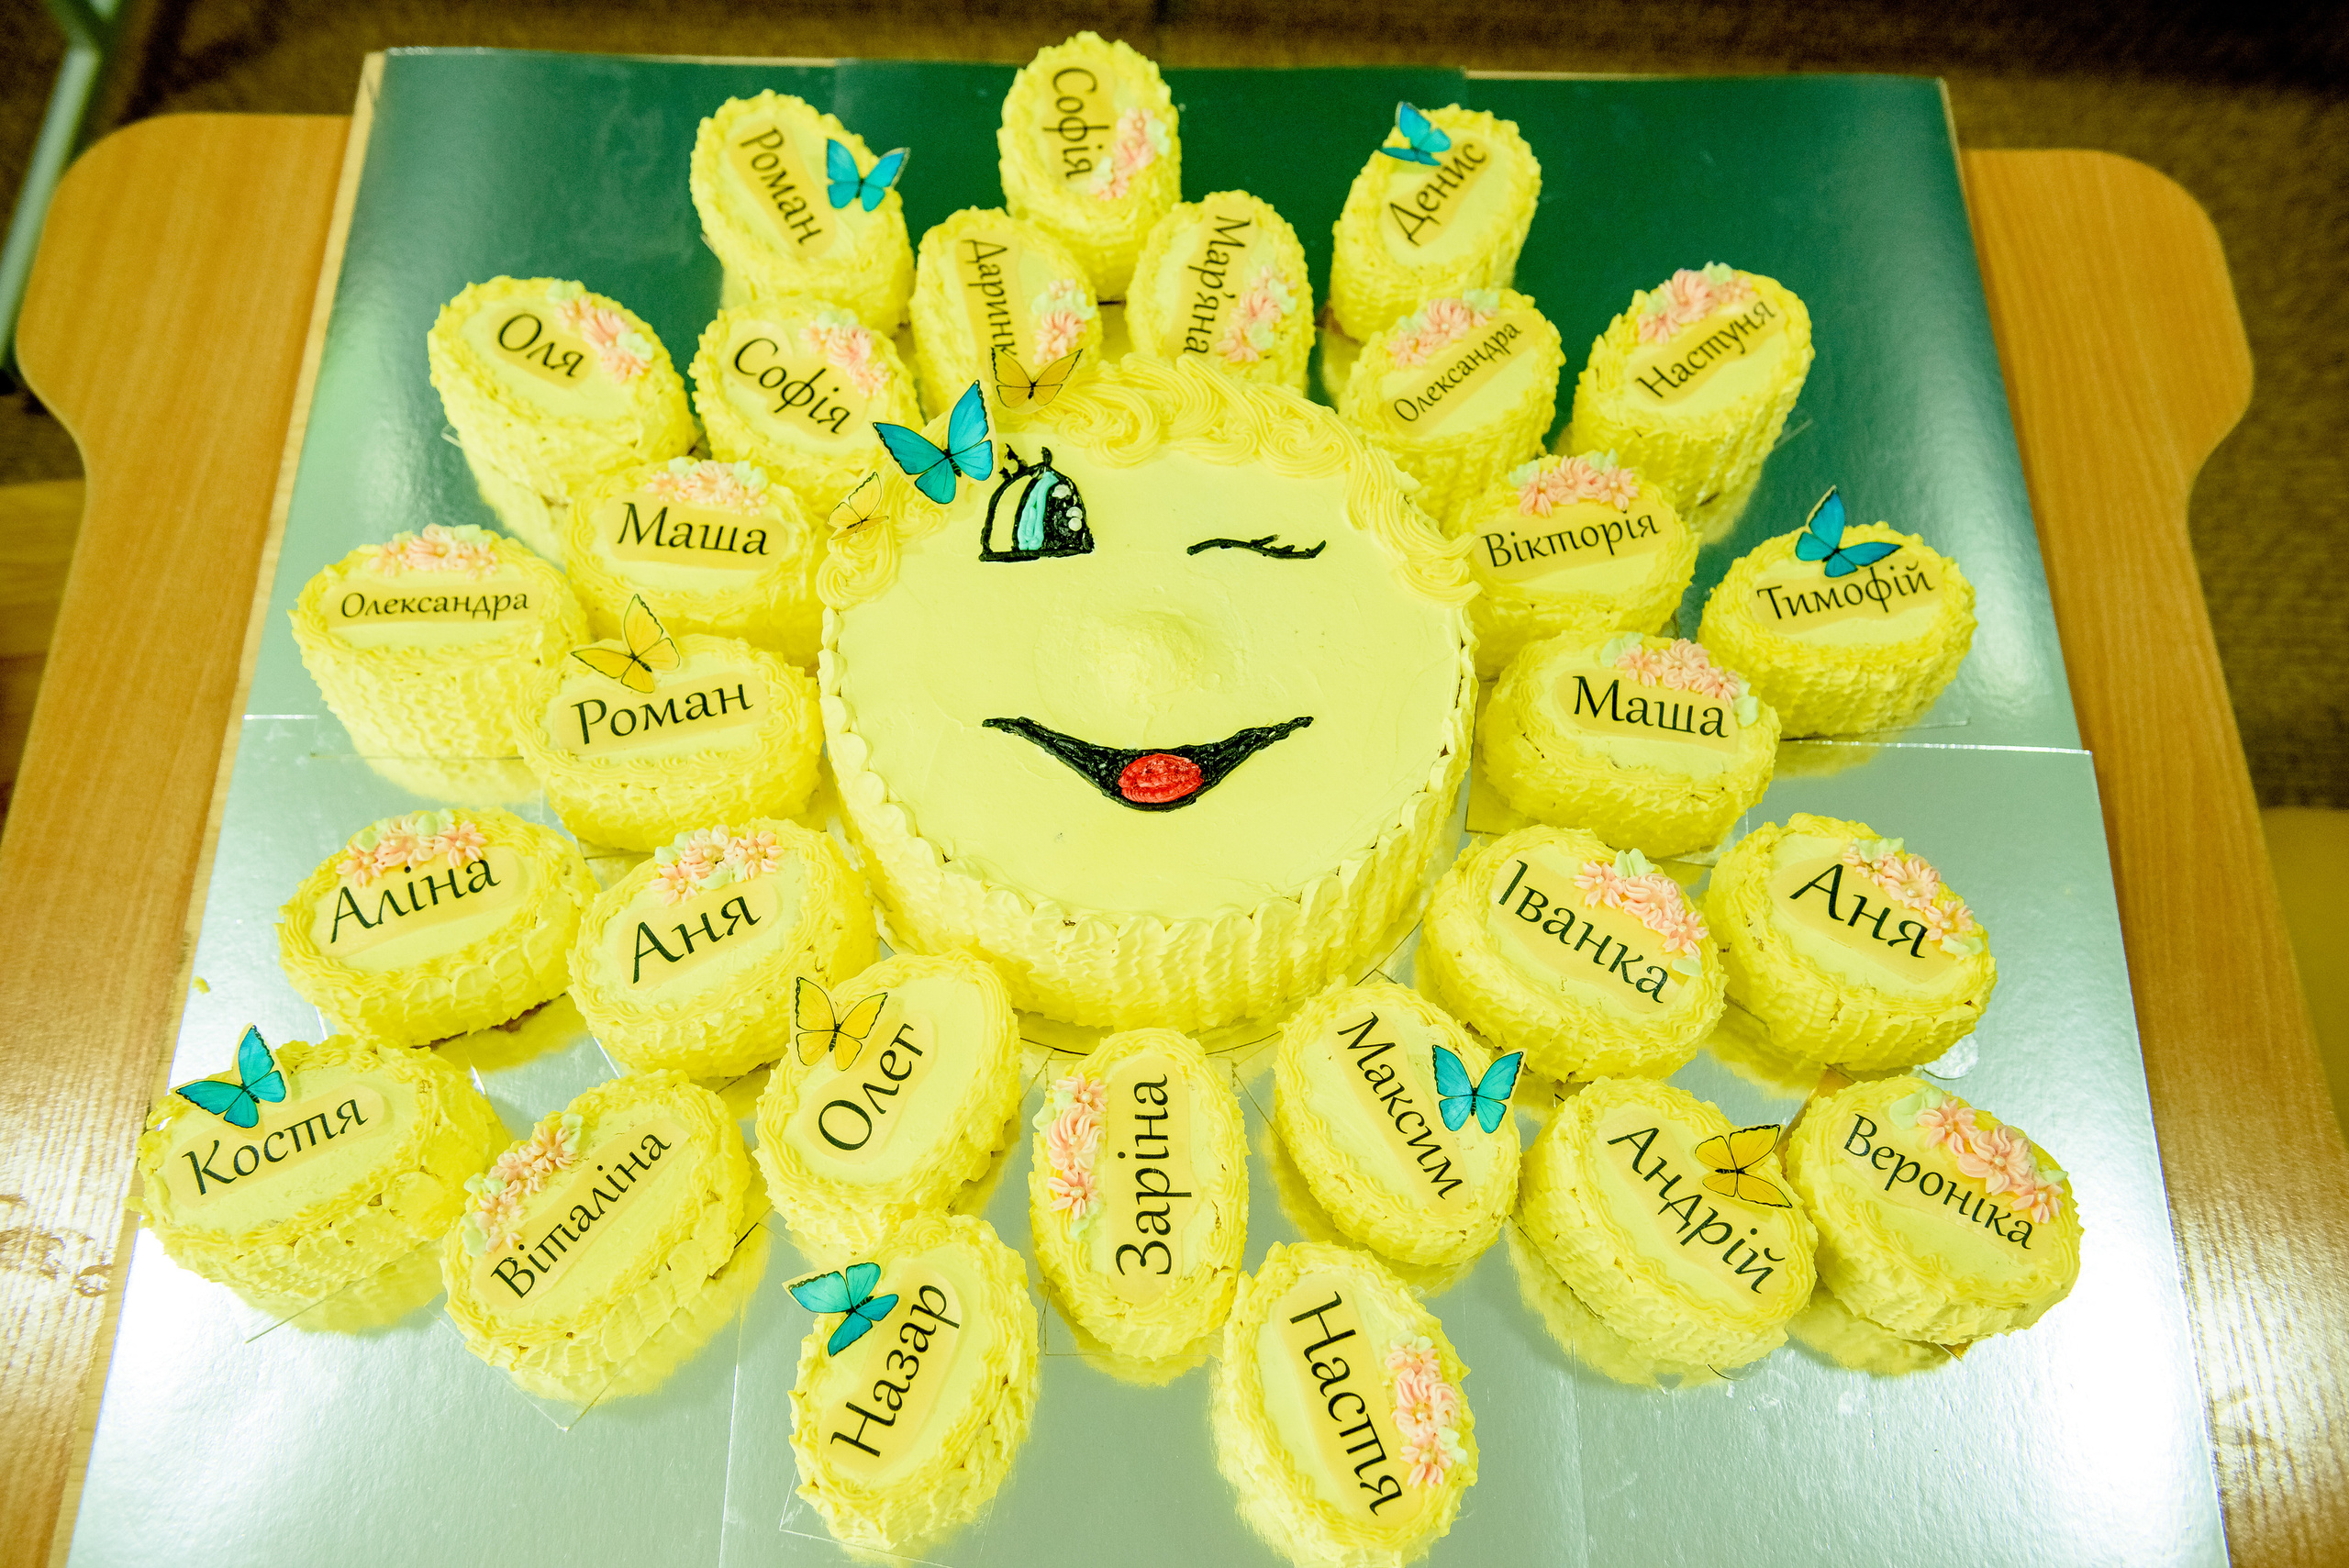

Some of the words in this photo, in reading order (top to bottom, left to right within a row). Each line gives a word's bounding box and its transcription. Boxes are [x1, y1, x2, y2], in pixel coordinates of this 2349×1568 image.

[1043, 67, 1109, 180] Софія
[739, 127, 822, 245] Роман
[1389, 143, 1487, 246] Денис
[963, 238, 1020, 356] Даринк
[1183, 216, 1252, 355] Мар'яна
[497, 313, 584, 379] Оля
[733, 337, 851, 435] Софія
[1393, 321, 1523, 423] Олександра
[1634, 297, 1778, 400] Настуня
[617, 502, 770, 556] Маша
[1480, 509, 1661, 569] Вікторія
[340, 588, 530, 622] Олександра
[1756, 561, 1935, 621] Тимофій
[570, 680, 753, 746] Роман
[1572, 675, 1730, 740] Маша
[330, 858, 501, 945] Аліна
[631, 894, 762, 984] Аня
[1497, 859, 1669, 1004] Іванка
[1789, 862, 1930, 960] Аня
[817, 1022, 926, 1152] Олег
[1336, 1011, 1464, 1201] Максим
[182, 1098, 369, 1197] Костя
[1115, 1073, 1193, 1278] Заріна
[1843, 1113, 2033, 1250] Вероніка
[490, 1130, 673, 1300] Віталіна
[1607, 1127, 1786, 1294] Андрій
[830, 1284, 961, 1458] Назар
[1289, 1290, 1404, 1516] Настя
